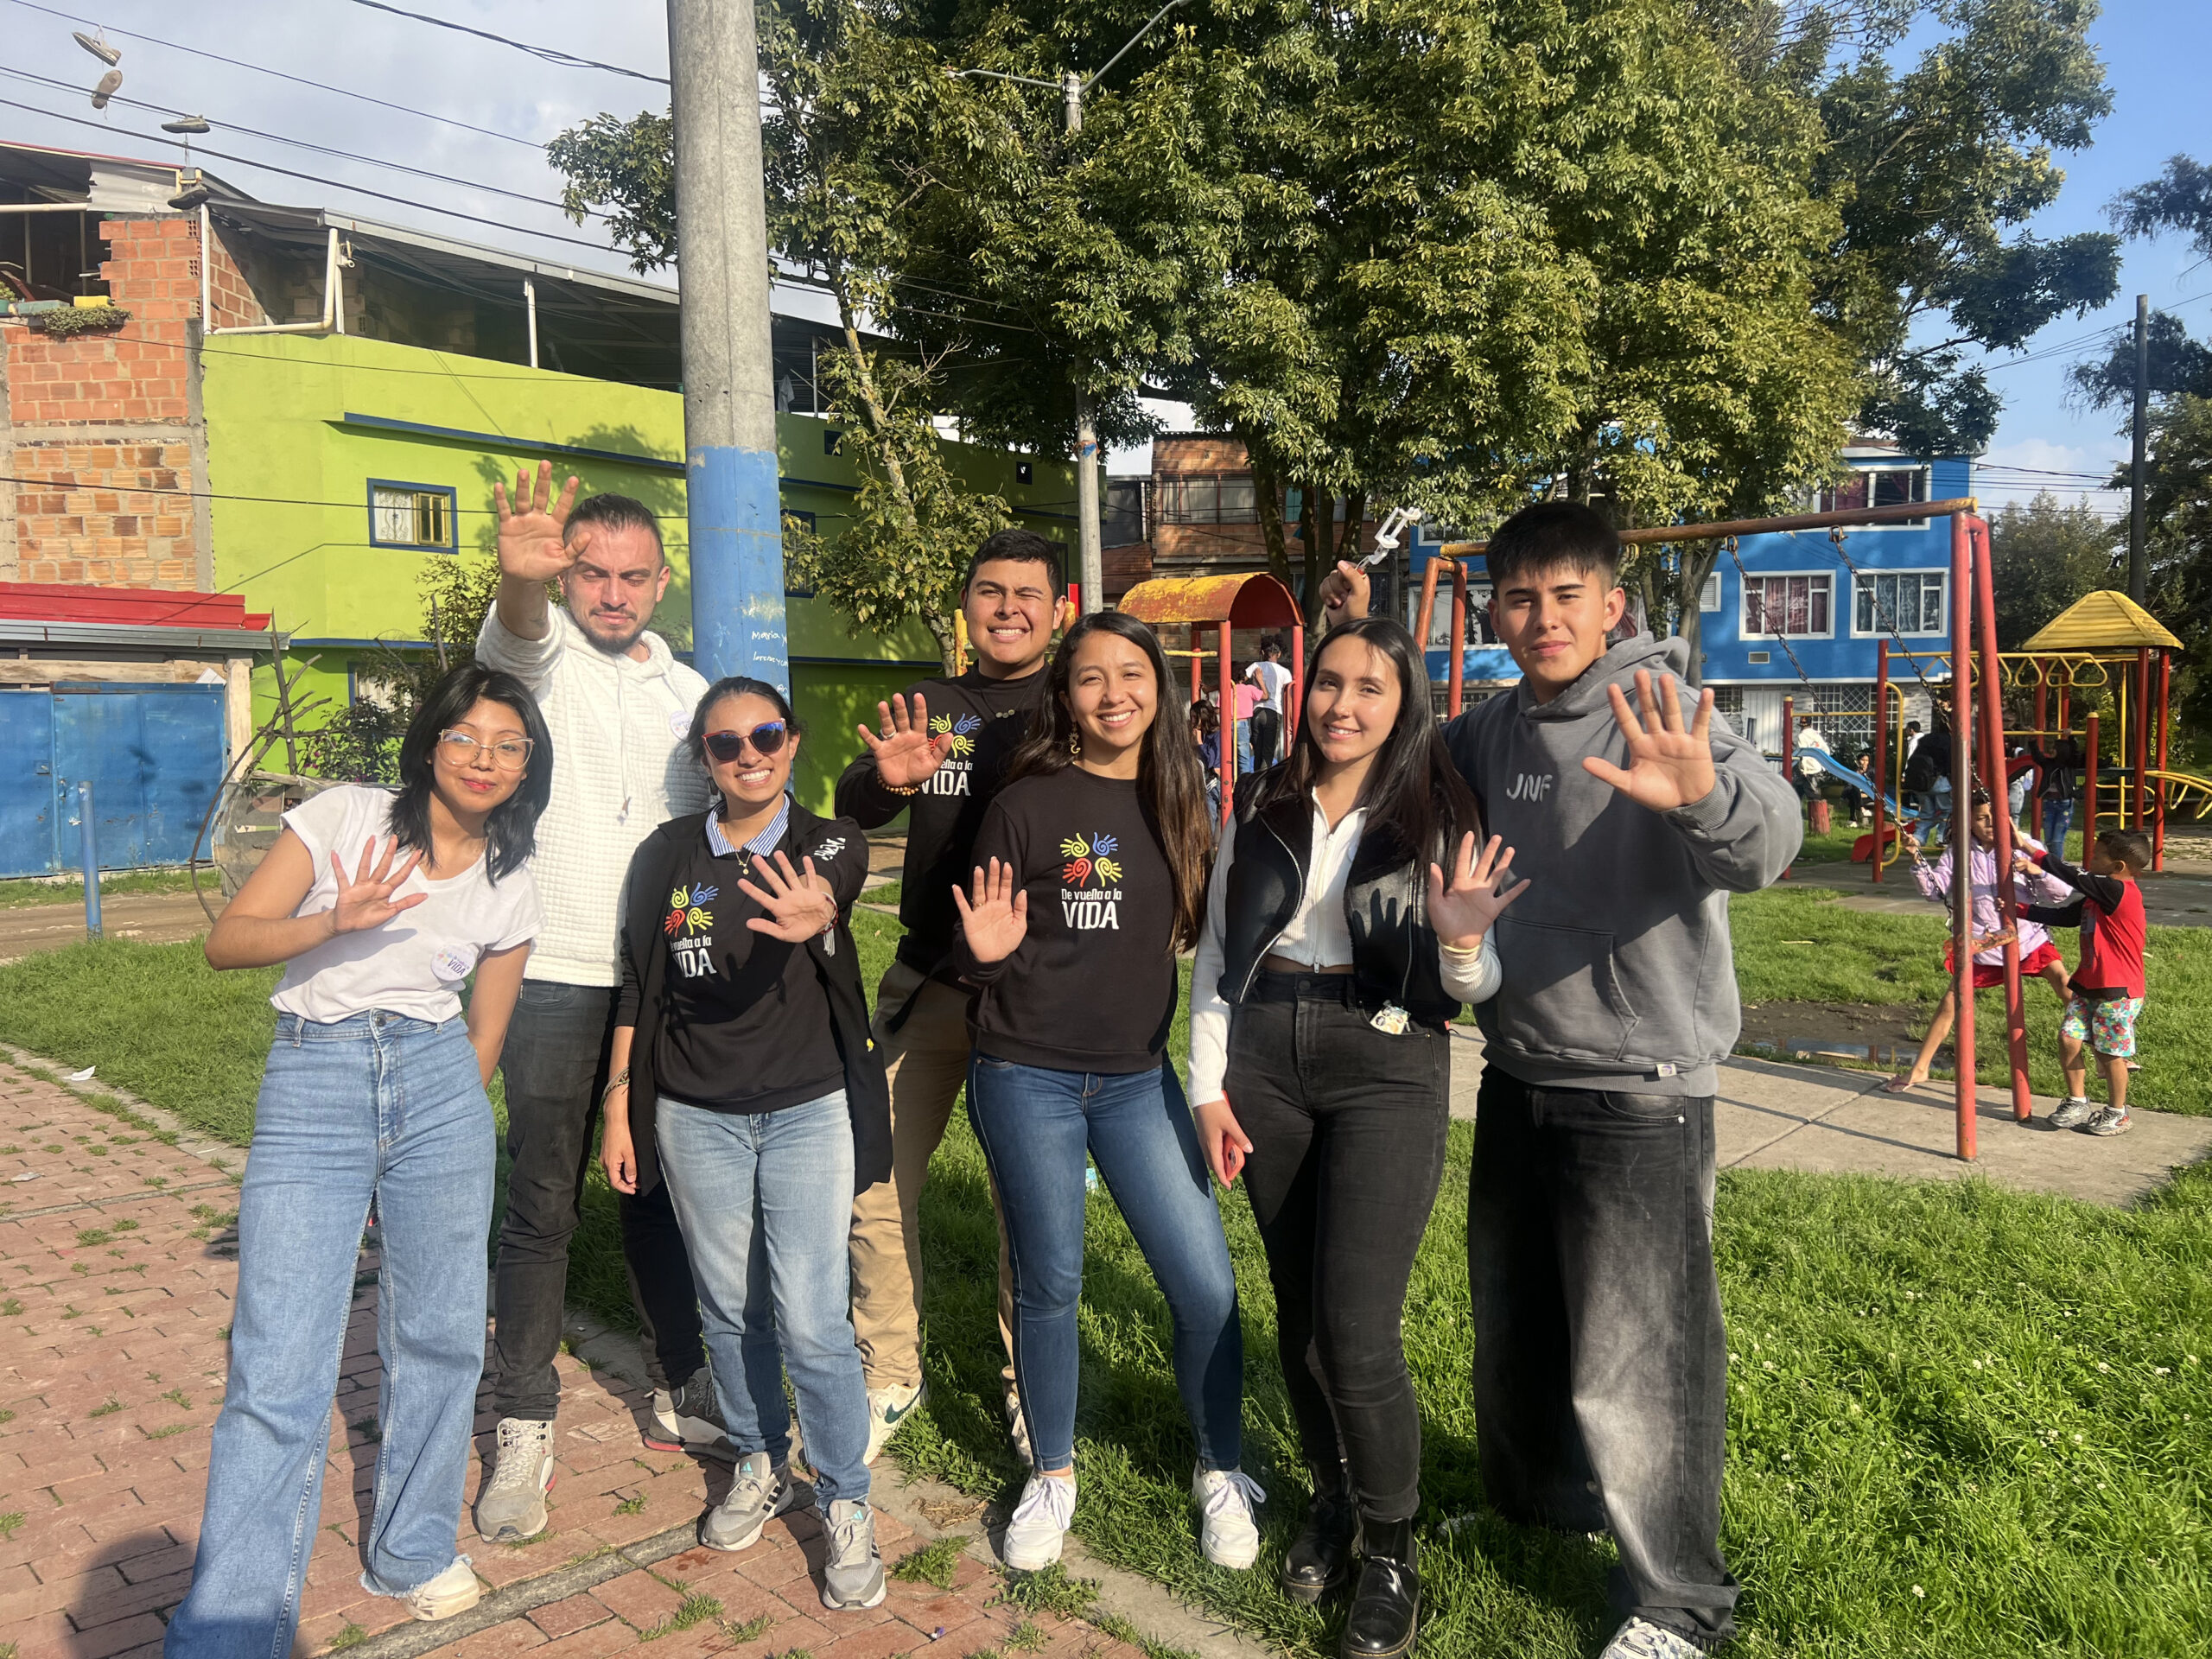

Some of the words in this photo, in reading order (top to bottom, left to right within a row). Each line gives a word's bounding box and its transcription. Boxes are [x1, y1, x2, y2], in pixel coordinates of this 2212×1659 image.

[957, 761, 963, 771] a
[964, 760, 974, 771] la
[1506, 772, 1553, 802] JNF
[1061, 888, 1073, 900] De
[1074, 888, 1104, 900] vuelta
[1104, 890, 1112, 900] a
[1113, 887, 1122, 900] la
[1061, 900, 1120, 930] VIDA
[694, 938, 702, 948] a
[702, 934, 713, 947] la
[448, 958, 467, 976] VIDA
